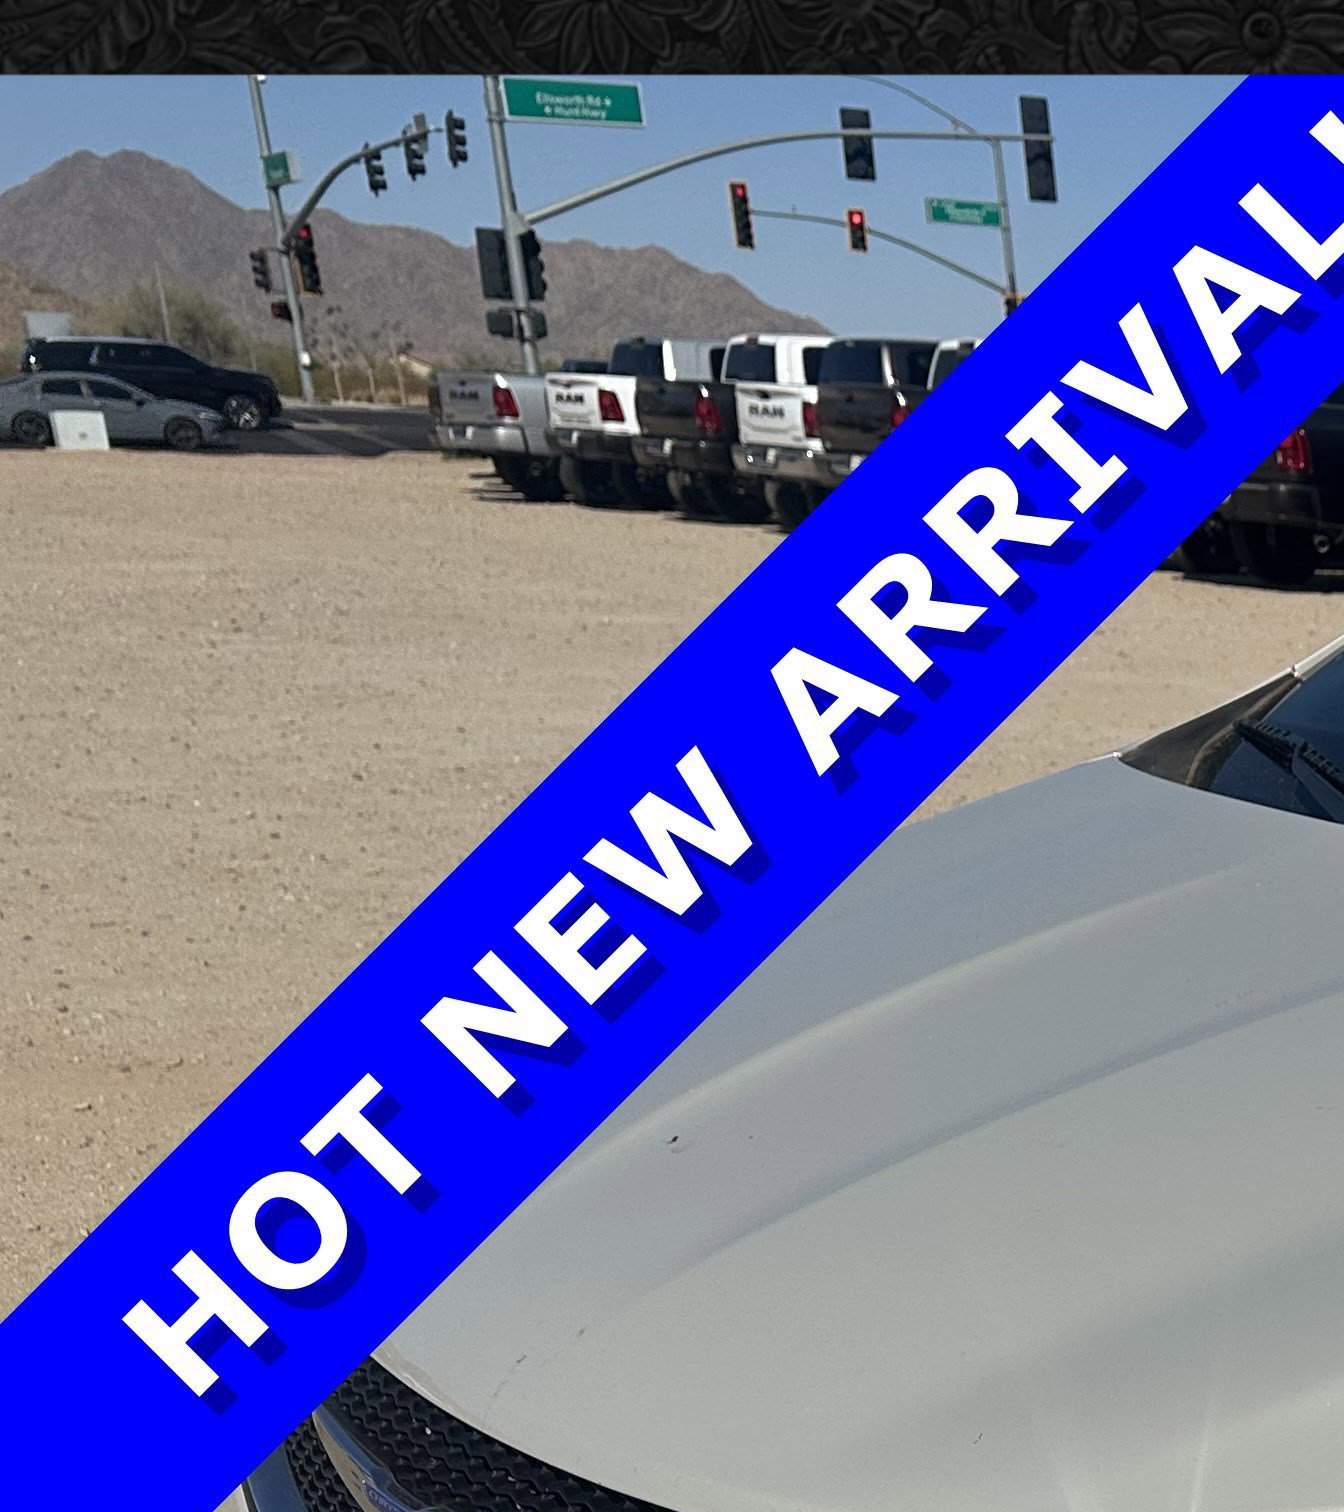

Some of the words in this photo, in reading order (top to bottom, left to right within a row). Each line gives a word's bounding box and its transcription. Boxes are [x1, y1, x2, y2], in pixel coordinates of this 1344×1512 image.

[449, 390, 480, 401] RAM
[555, 393, 585, 405] RAM
[748, 404, 786, 419] RAM
